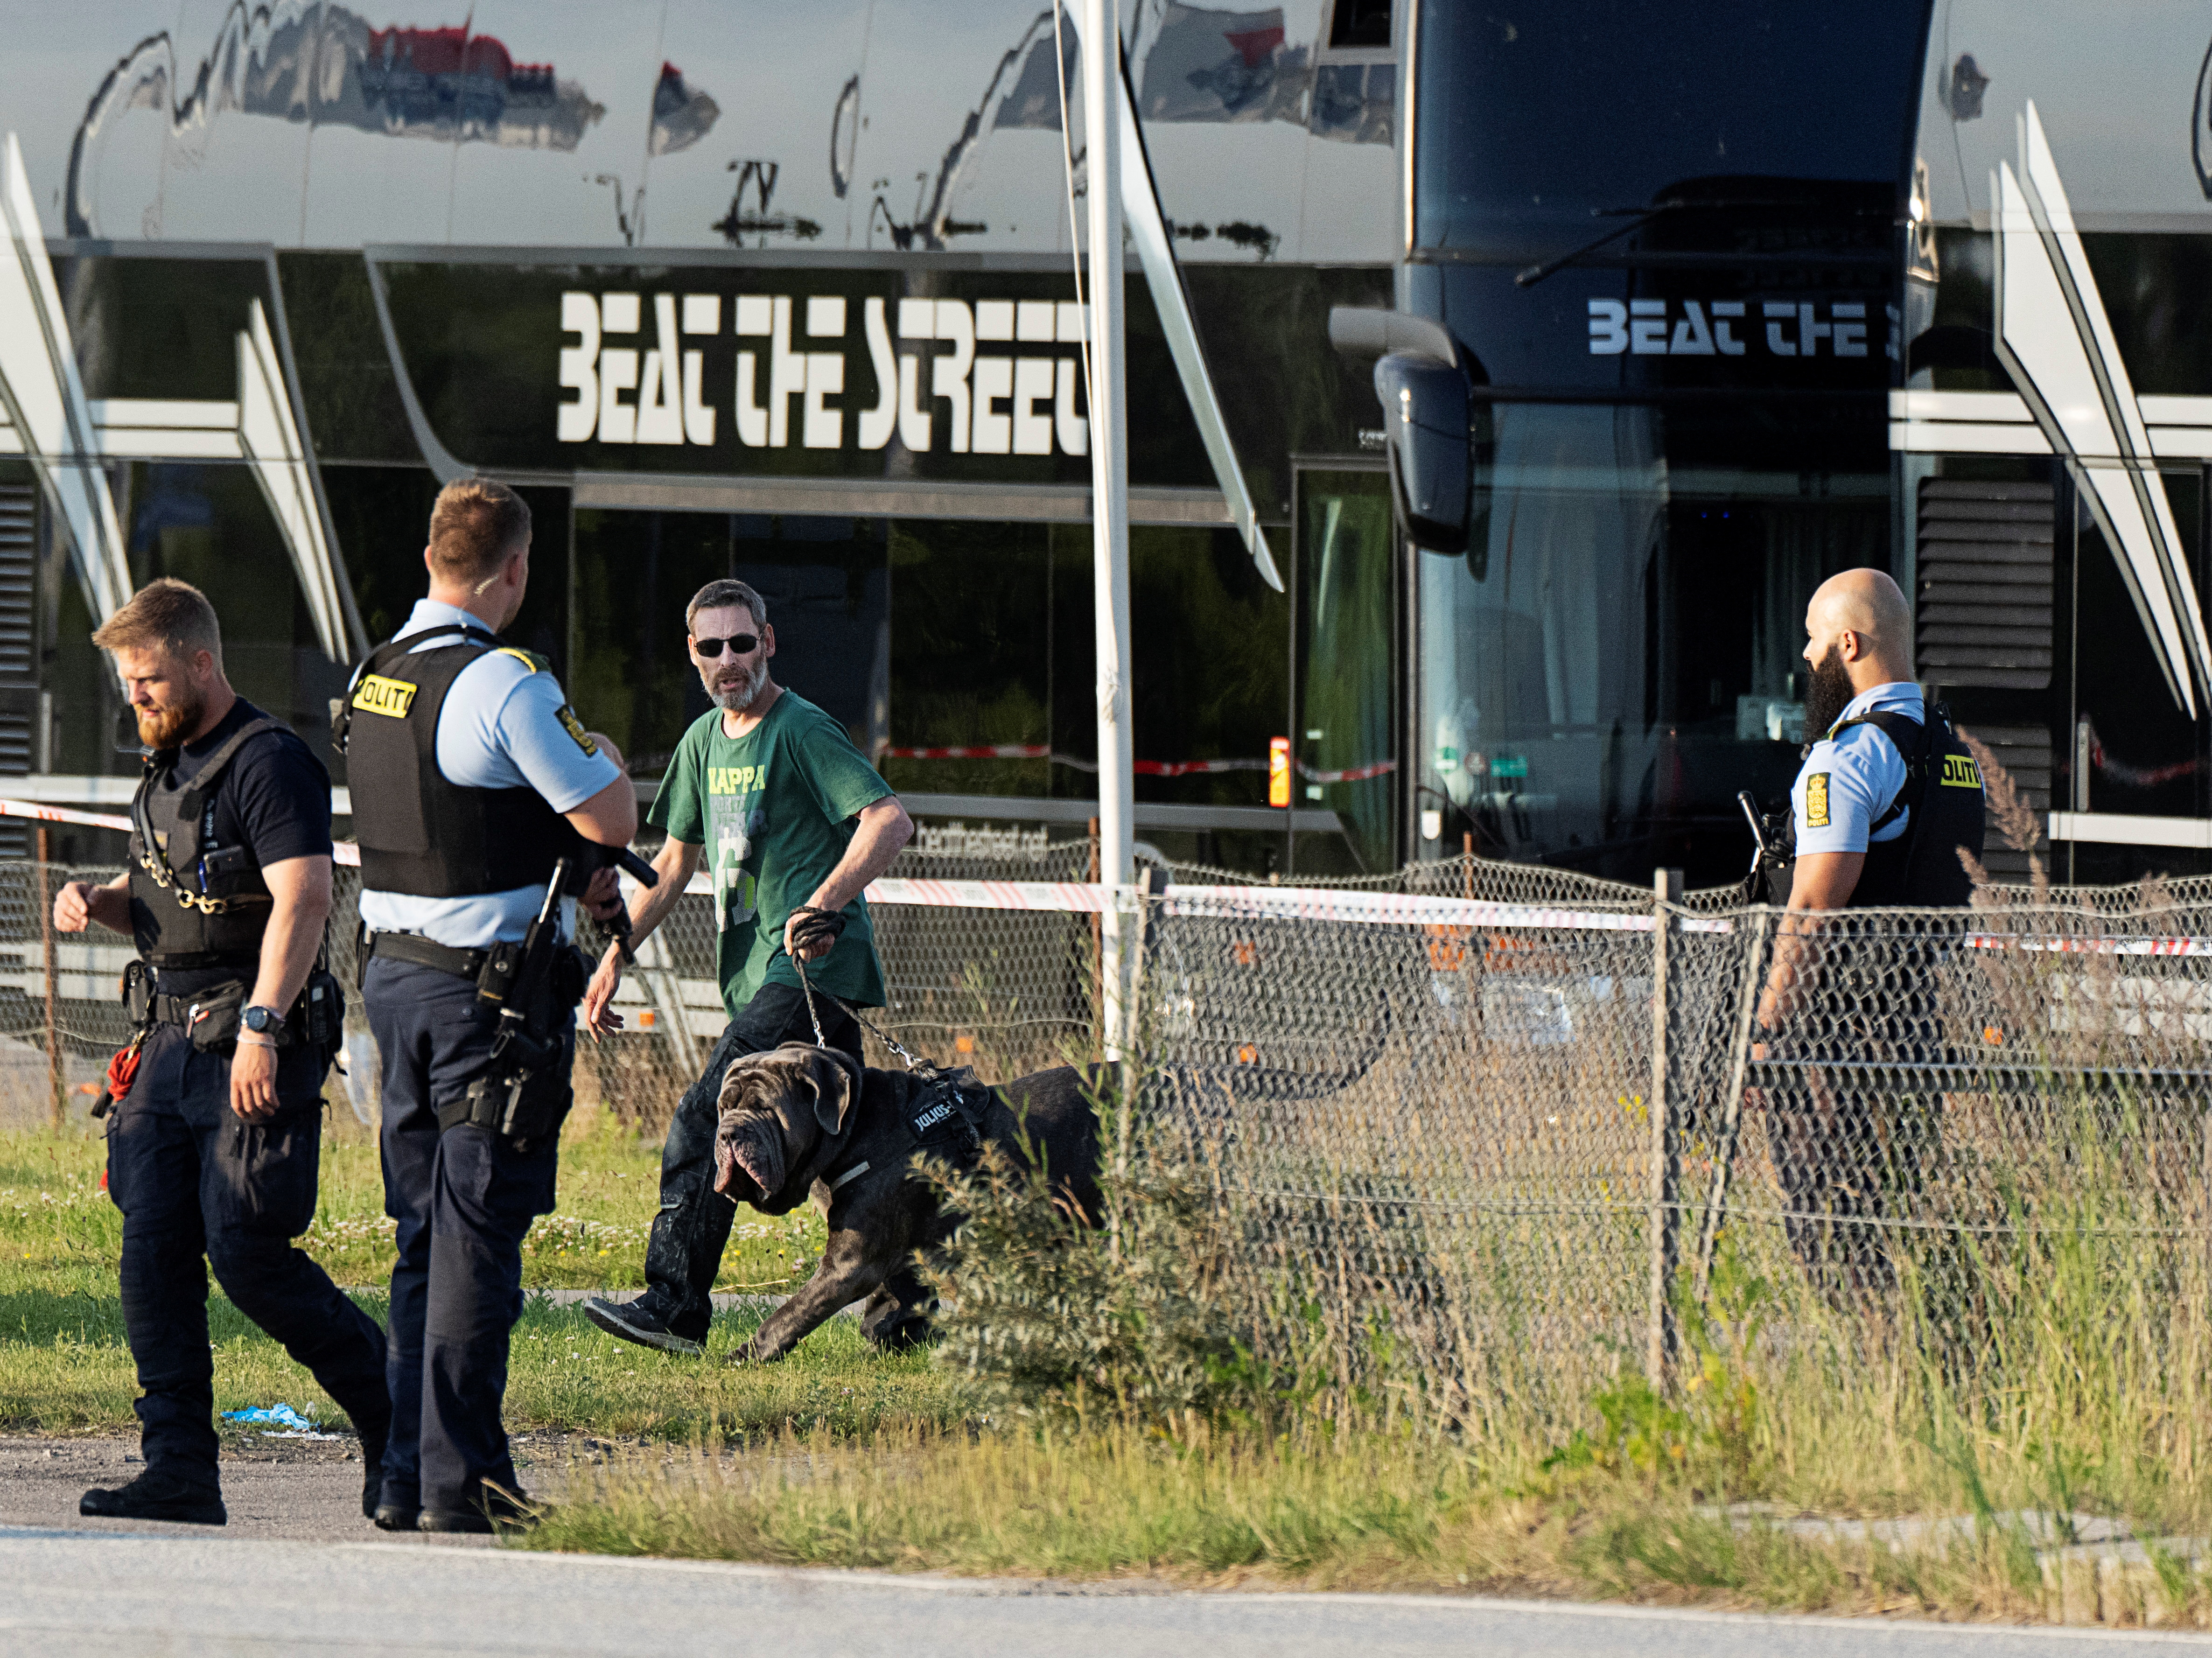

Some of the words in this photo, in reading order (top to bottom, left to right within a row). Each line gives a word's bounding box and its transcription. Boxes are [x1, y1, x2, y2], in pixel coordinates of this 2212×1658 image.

[1588, 298, 1746, 356] BEAT
[1763, 300, 1869, 357] THE
[557, 290, 721, 446] BEAT
[734, 295, 847, 449] THE
[858, 296, 1092, 457] STREET
[357, 680, 414, 711] OLITI
[707, 764, 766, 795] KAPPA
[1940, 758, 1980, 784] OLITI
[1808, 818, 1829, 827] POLITI
